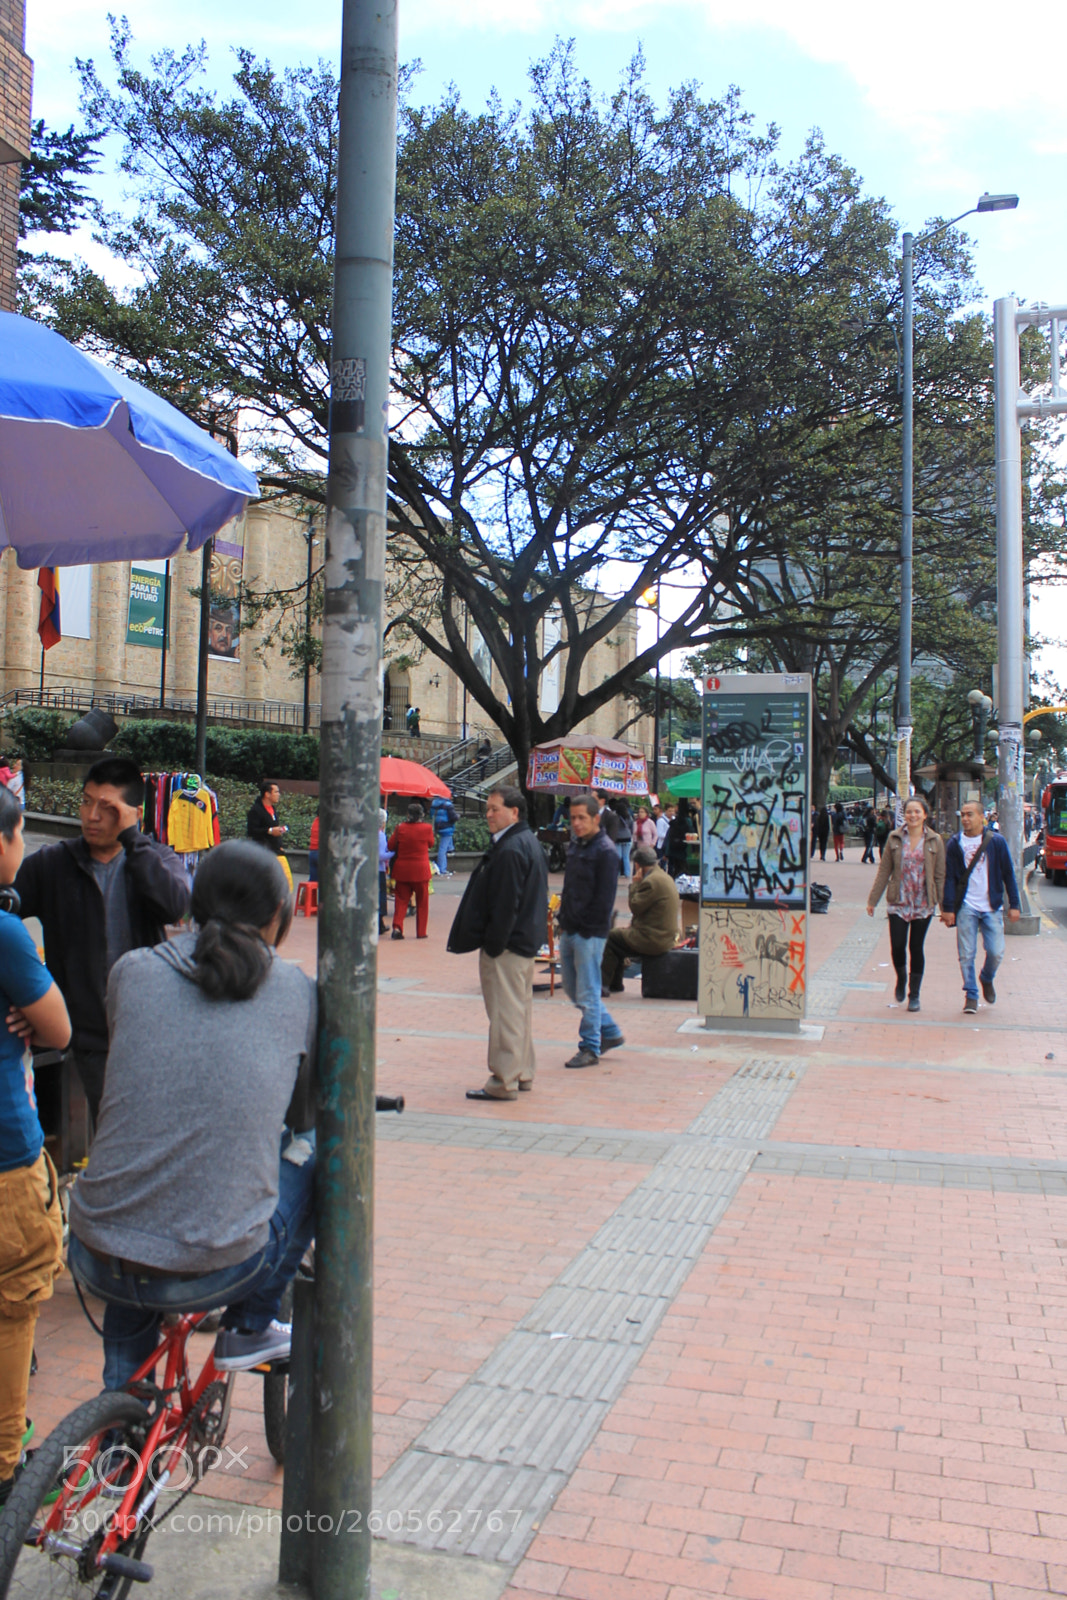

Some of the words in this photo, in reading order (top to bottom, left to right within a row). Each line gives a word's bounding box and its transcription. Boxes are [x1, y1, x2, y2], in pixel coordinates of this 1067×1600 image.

[131, 574, 161, 587] ENERGÍA
[130, 582, 150, 593] PARA
[151, 586, 159, 595] EL
[130, 590, 158, 602] FUTURO
[595, 757, 626, 770] 2.500
[708, 755, 739, 763] Centro
[740, 754, 802, 763] Ineracioal
[592, 777, 625, 791] 3.000
